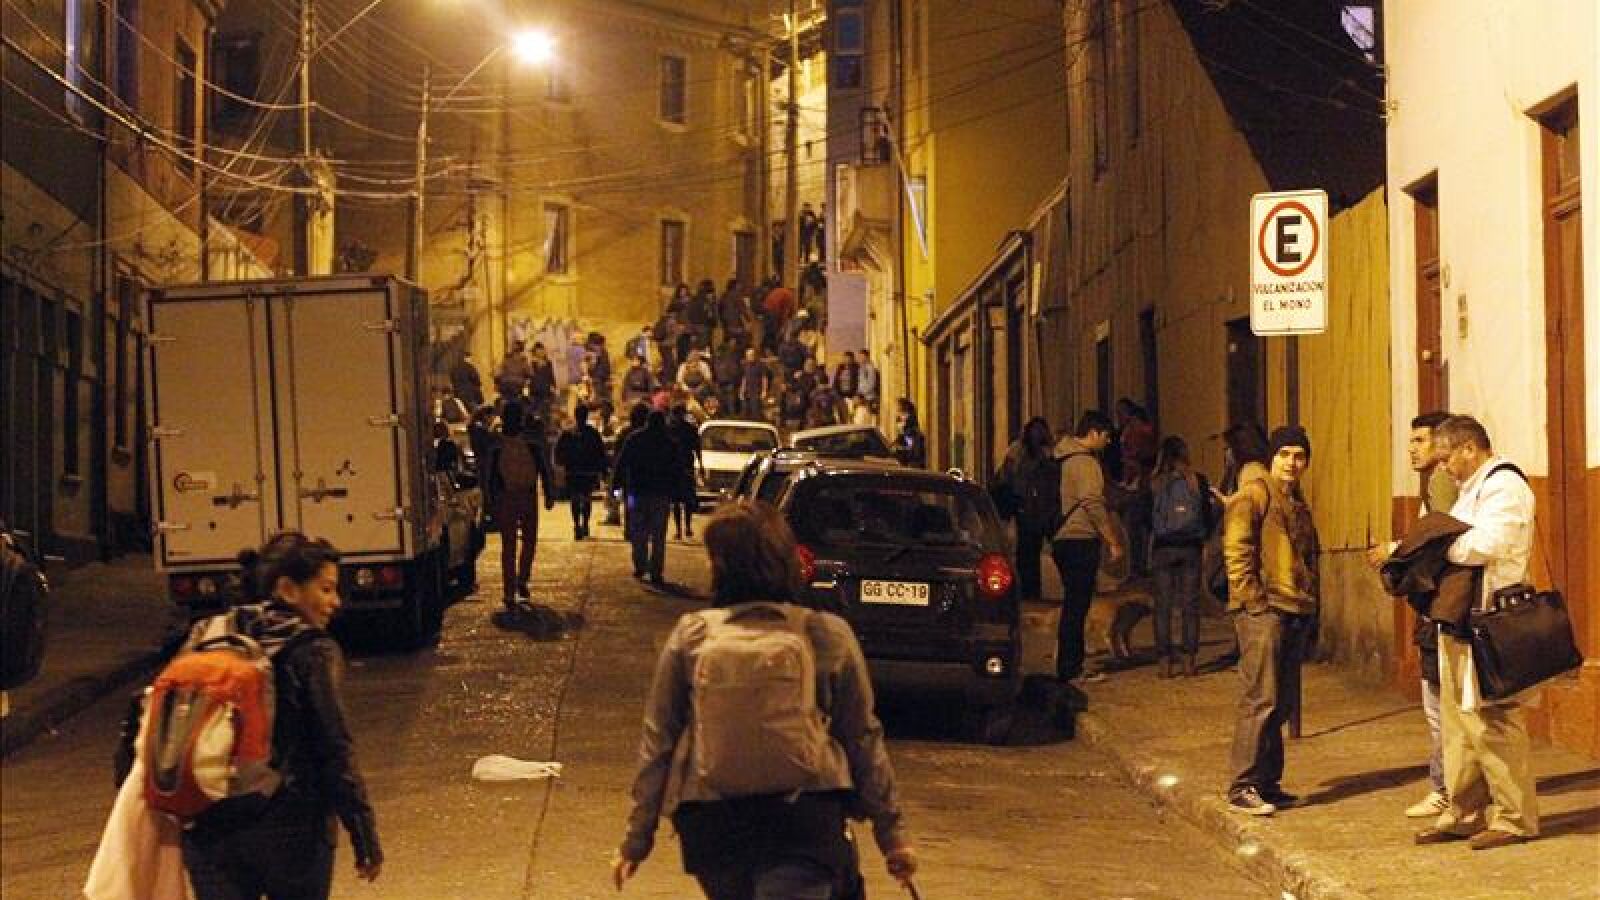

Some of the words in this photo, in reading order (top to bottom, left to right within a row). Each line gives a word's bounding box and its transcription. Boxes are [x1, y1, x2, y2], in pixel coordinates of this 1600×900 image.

[1276, 215, 1302, 263] E
[1264, 300, 1275, 311] EL
[1279, 298, 1312, 310] MONO
